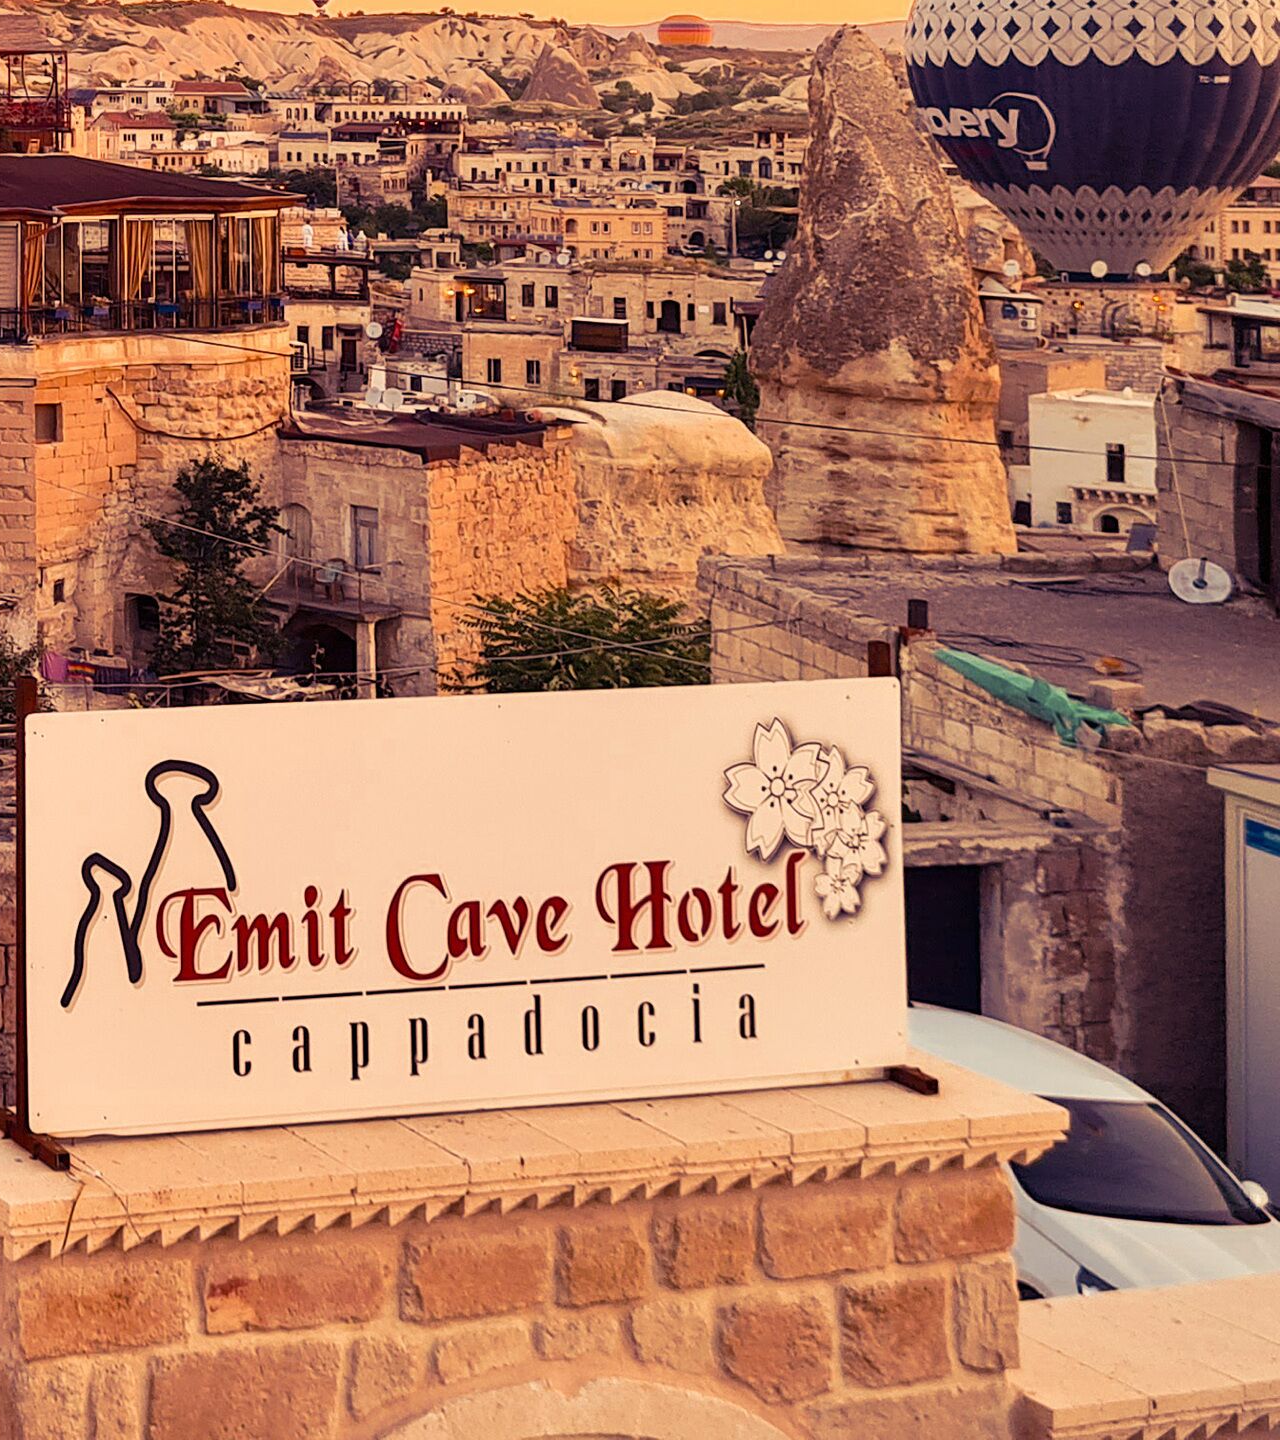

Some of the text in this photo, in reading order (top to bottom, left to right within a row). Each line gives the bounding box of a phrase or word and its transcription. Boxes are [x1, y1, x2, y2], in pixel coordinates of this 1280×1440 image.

[918, 107, 1020, 148] overy
[156, 851, 806, 981] Emit Cave Hotel
[231, 984, 758, 1081] cappadocia
